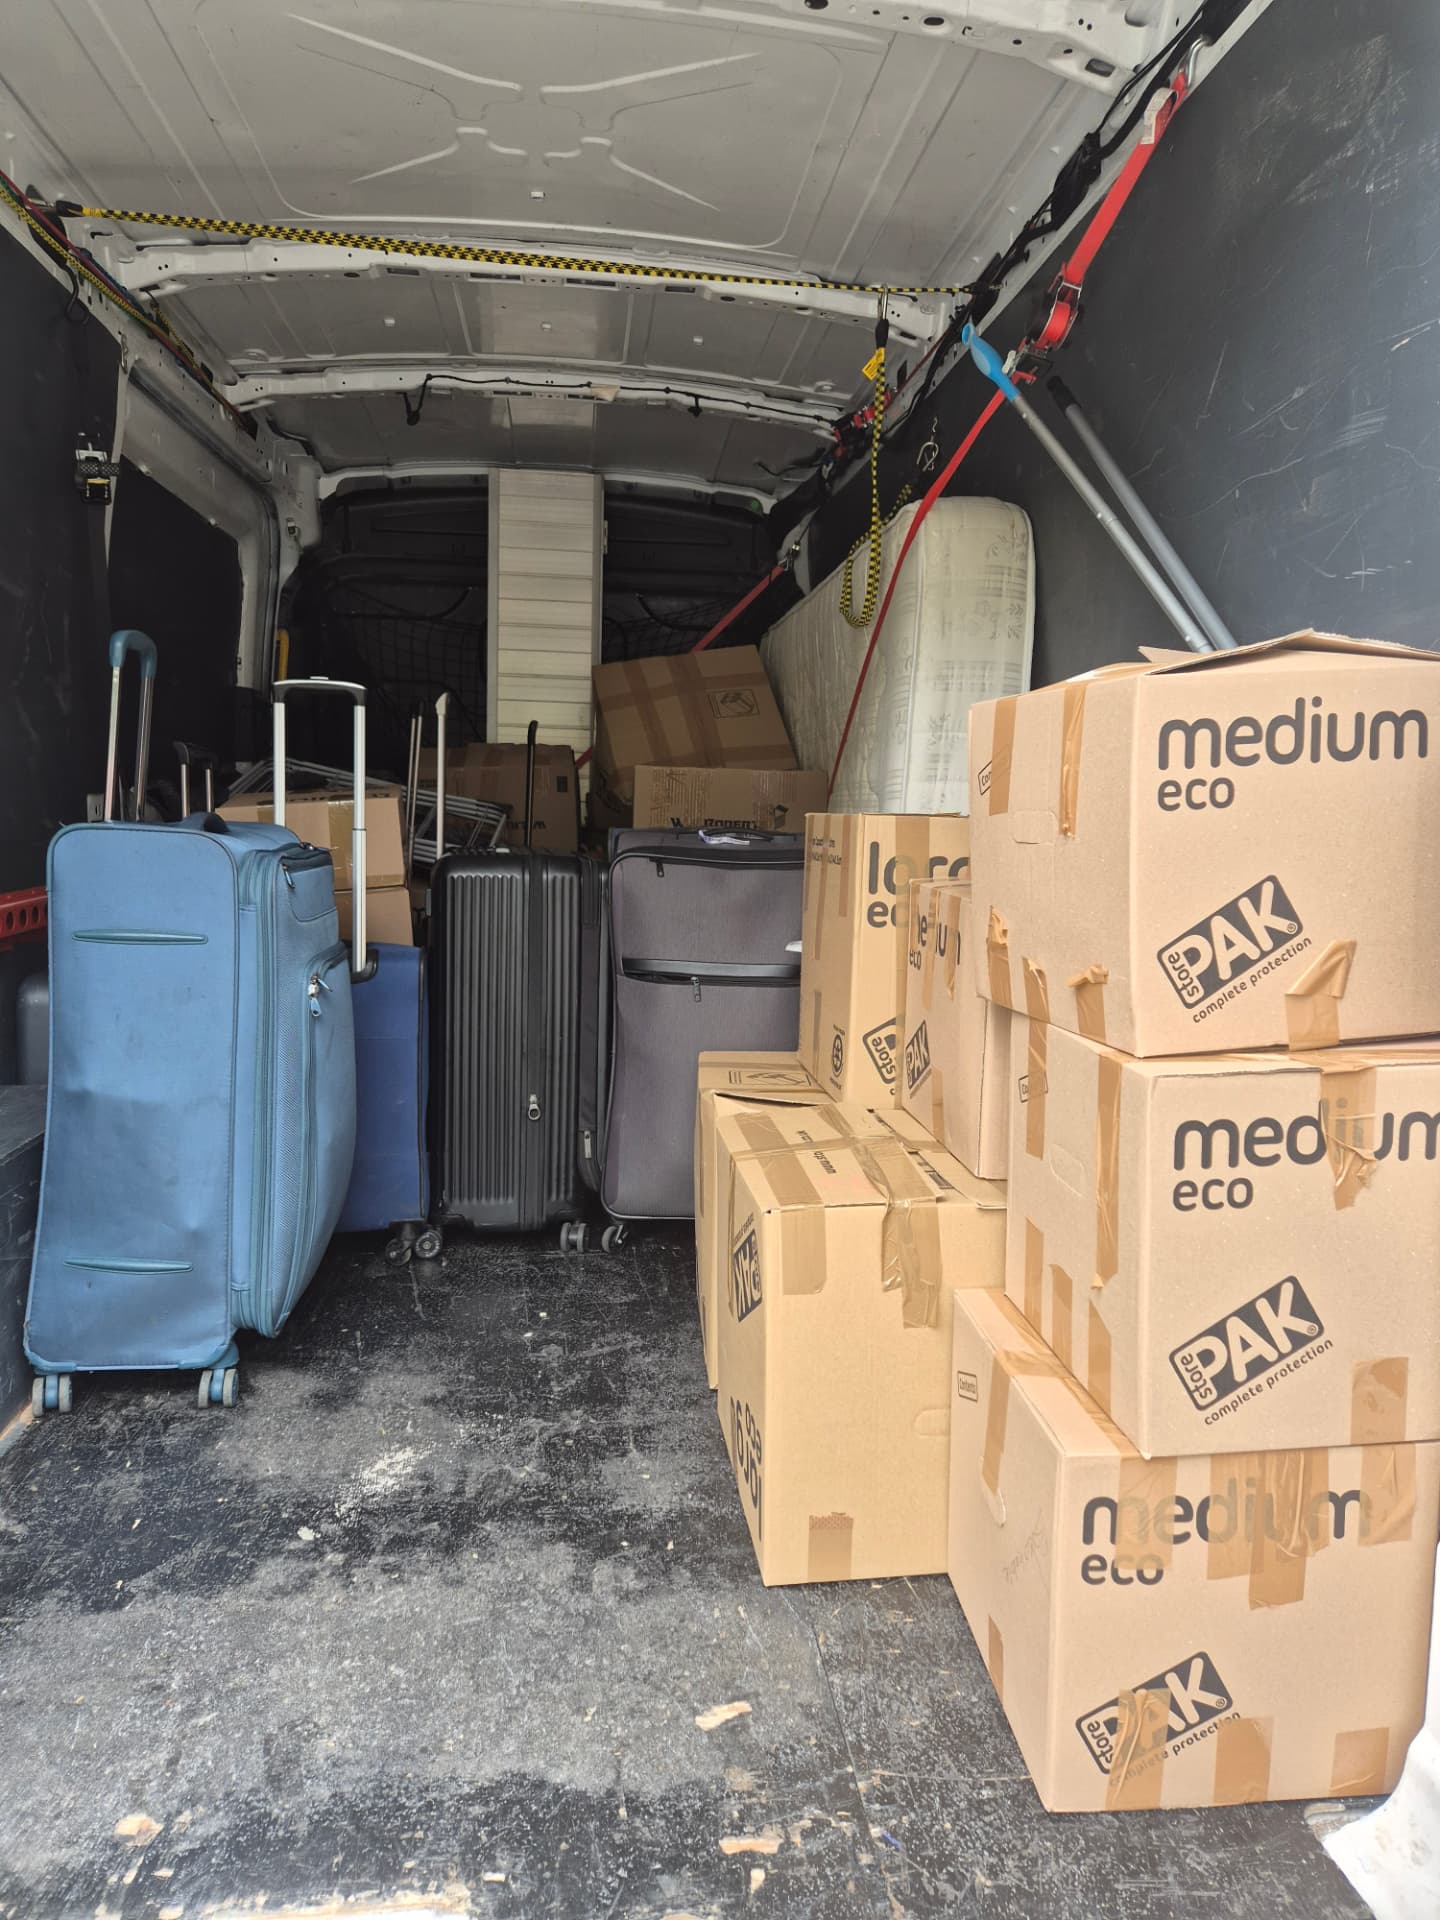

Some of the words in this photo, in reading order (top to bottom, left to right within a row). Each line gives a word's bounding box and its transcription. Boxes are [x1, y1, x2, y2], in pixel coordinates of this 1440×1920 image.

[1157, 695, 1429, 771] medium
[1157, 776, 1236, 811] eco
[1162, 880, 1298, 1005] PAK
[1167, 950, 1200, 998] store
[1192, 980, 1249, 1024] complete
[1249, 936, 1313, 987] protection
[871, 1036, 896, 1075] store
[1172, 1177, 1254, 1212] eco
[1174, 1281, 1319, 1407] PAK
[1180, 1352, 1214, 1400] store
[1203, 1382, 1265, 1426] complete
[1265, 1338, 1334, 1389] protection
[1082, 1476, 1373, 1546] medium
[1081, 1553, 1164, 1585] eco
